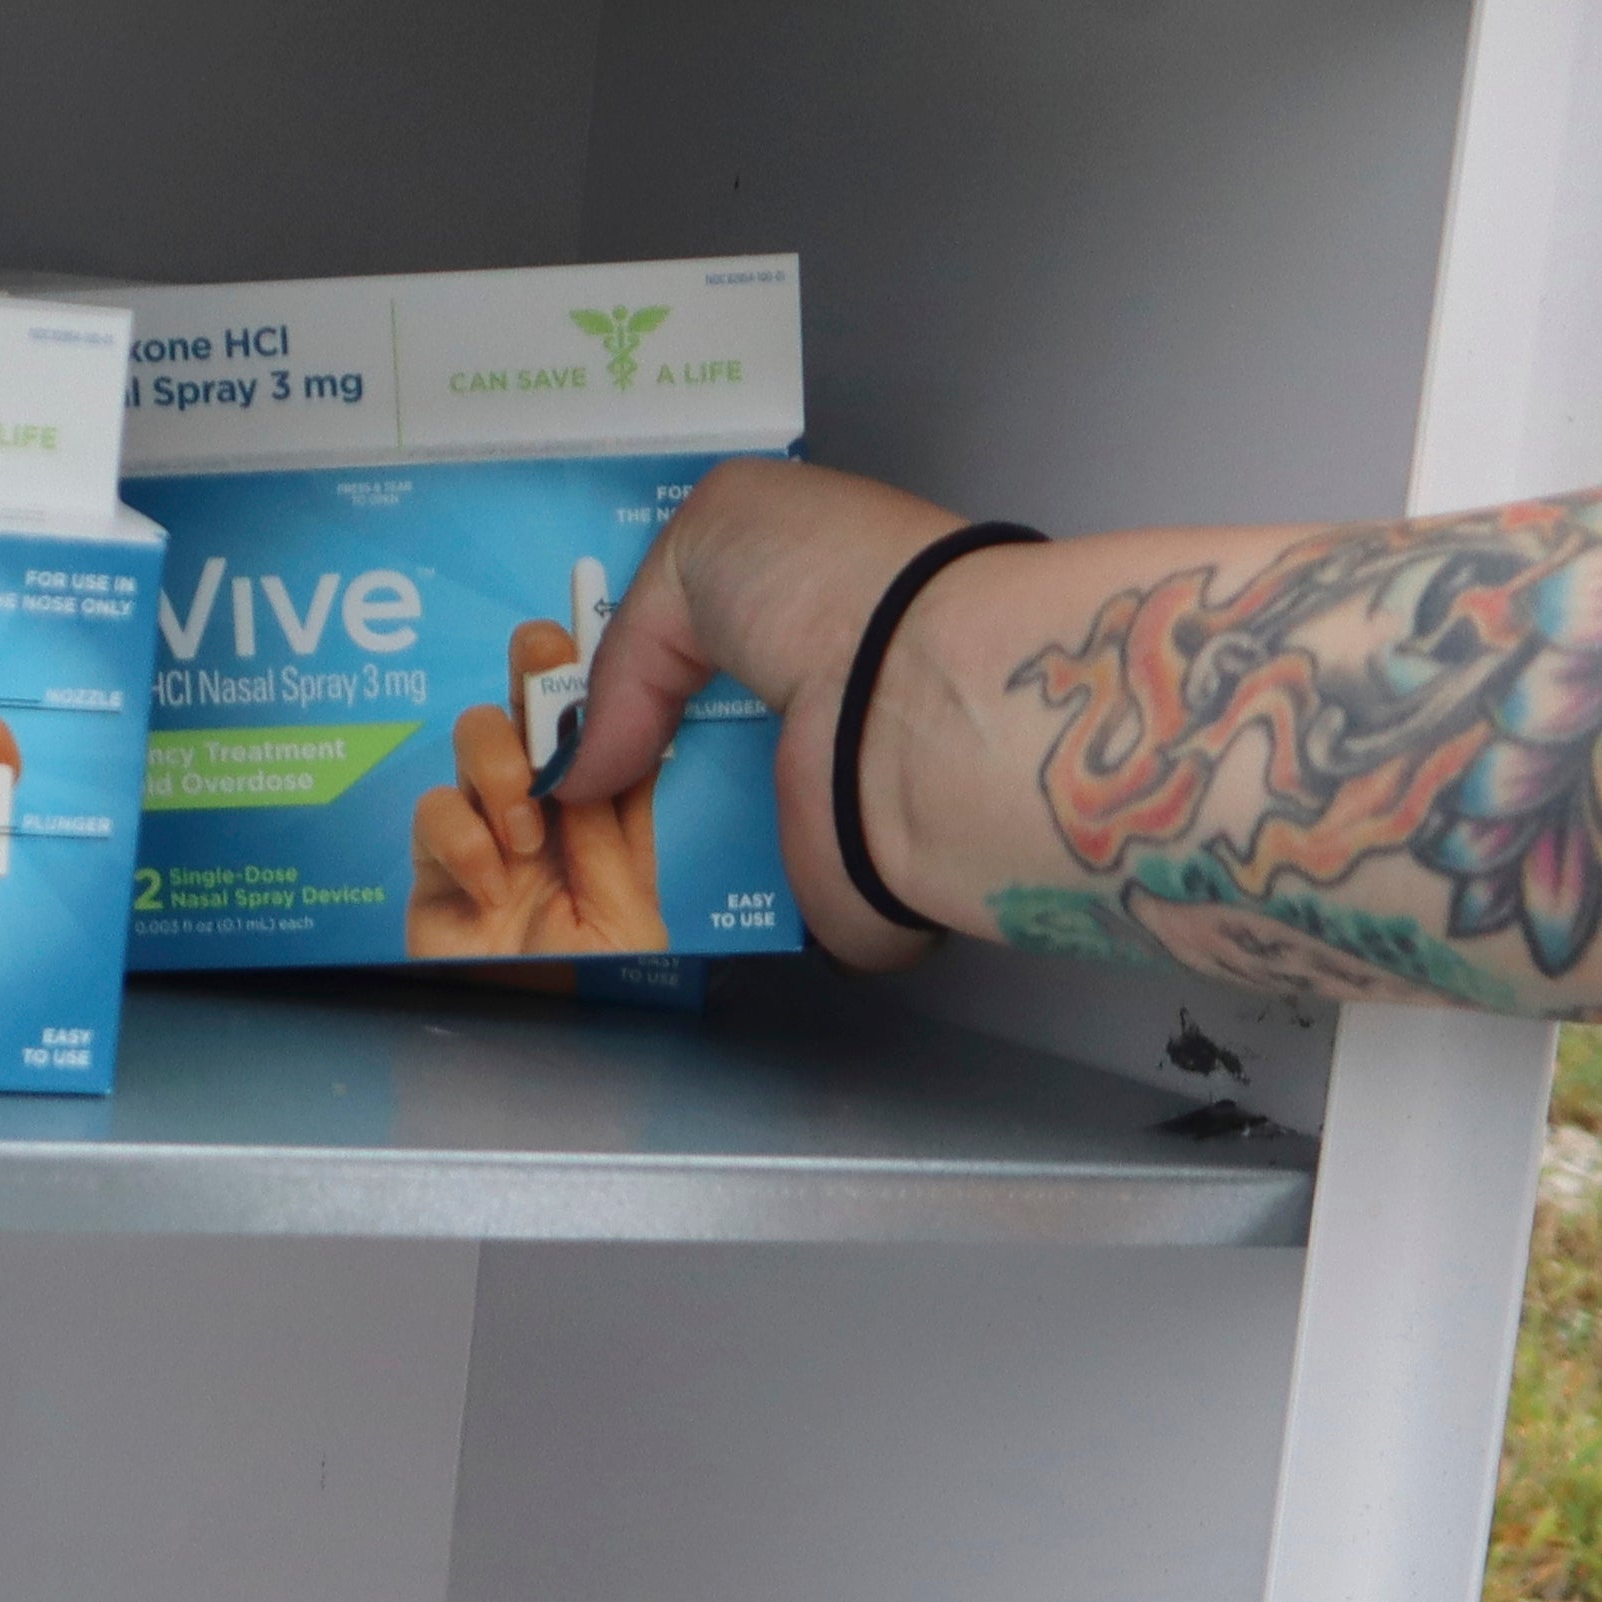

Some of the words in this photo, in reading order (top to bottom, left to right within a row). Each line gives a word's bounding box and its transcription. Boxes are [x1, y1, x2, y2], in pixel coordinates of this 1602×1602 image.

[224, 325, 289, 358] HCl
[448, 371, 508, 394] CAN
[517, 368, 587, 392] SAVE
[655, 363, 675, 385] A
[684, 360, 742, 385] LIFE
[152, 374, 257, 411] Spray
[270, 371, 291, 400] 3
[304, 370, 364, 404] mg
[617, 507, 651, 523] THE
[25, 570, 64, 589] FOR
[71, 573, 109, 592] USE
[114, 576, 136, 593] IN
[22, 592, 75, 614] NOSE
[81, 597, 134, 617] ONLY
[199, 668, 275, 704] Nasal
[282, 665, 357, 708] Spray
[363, 663, 379, 698] 3
[386, 669, 426, 705] mg
[45, 687, 124, 709] NOZZLE
[206, 740, 345, 765] Treatment
[181, 769, 314, 795] Overdose
[22, 813, 113, 833] PLUNGER
[134, 867, 163, 910] 2
[169, 866, 298, 888] Single-Dose
[170, 890, 228, 908] Nasal
[235, 888, 294, 909] Spray
[302, 885, 385, 905] Devices
[727, 893, 776, 909] EASY
[135, 919, 179, 935] 0.003
[279, 916, 314, 931] each
[710, 912, 736, 929] TO
[740, 911, 776, 927] USE
[42, 1028, 94, 1045] EASY
[22, 1048, 48, 1067] TO
[52, 1049, 91, 1067] USE
